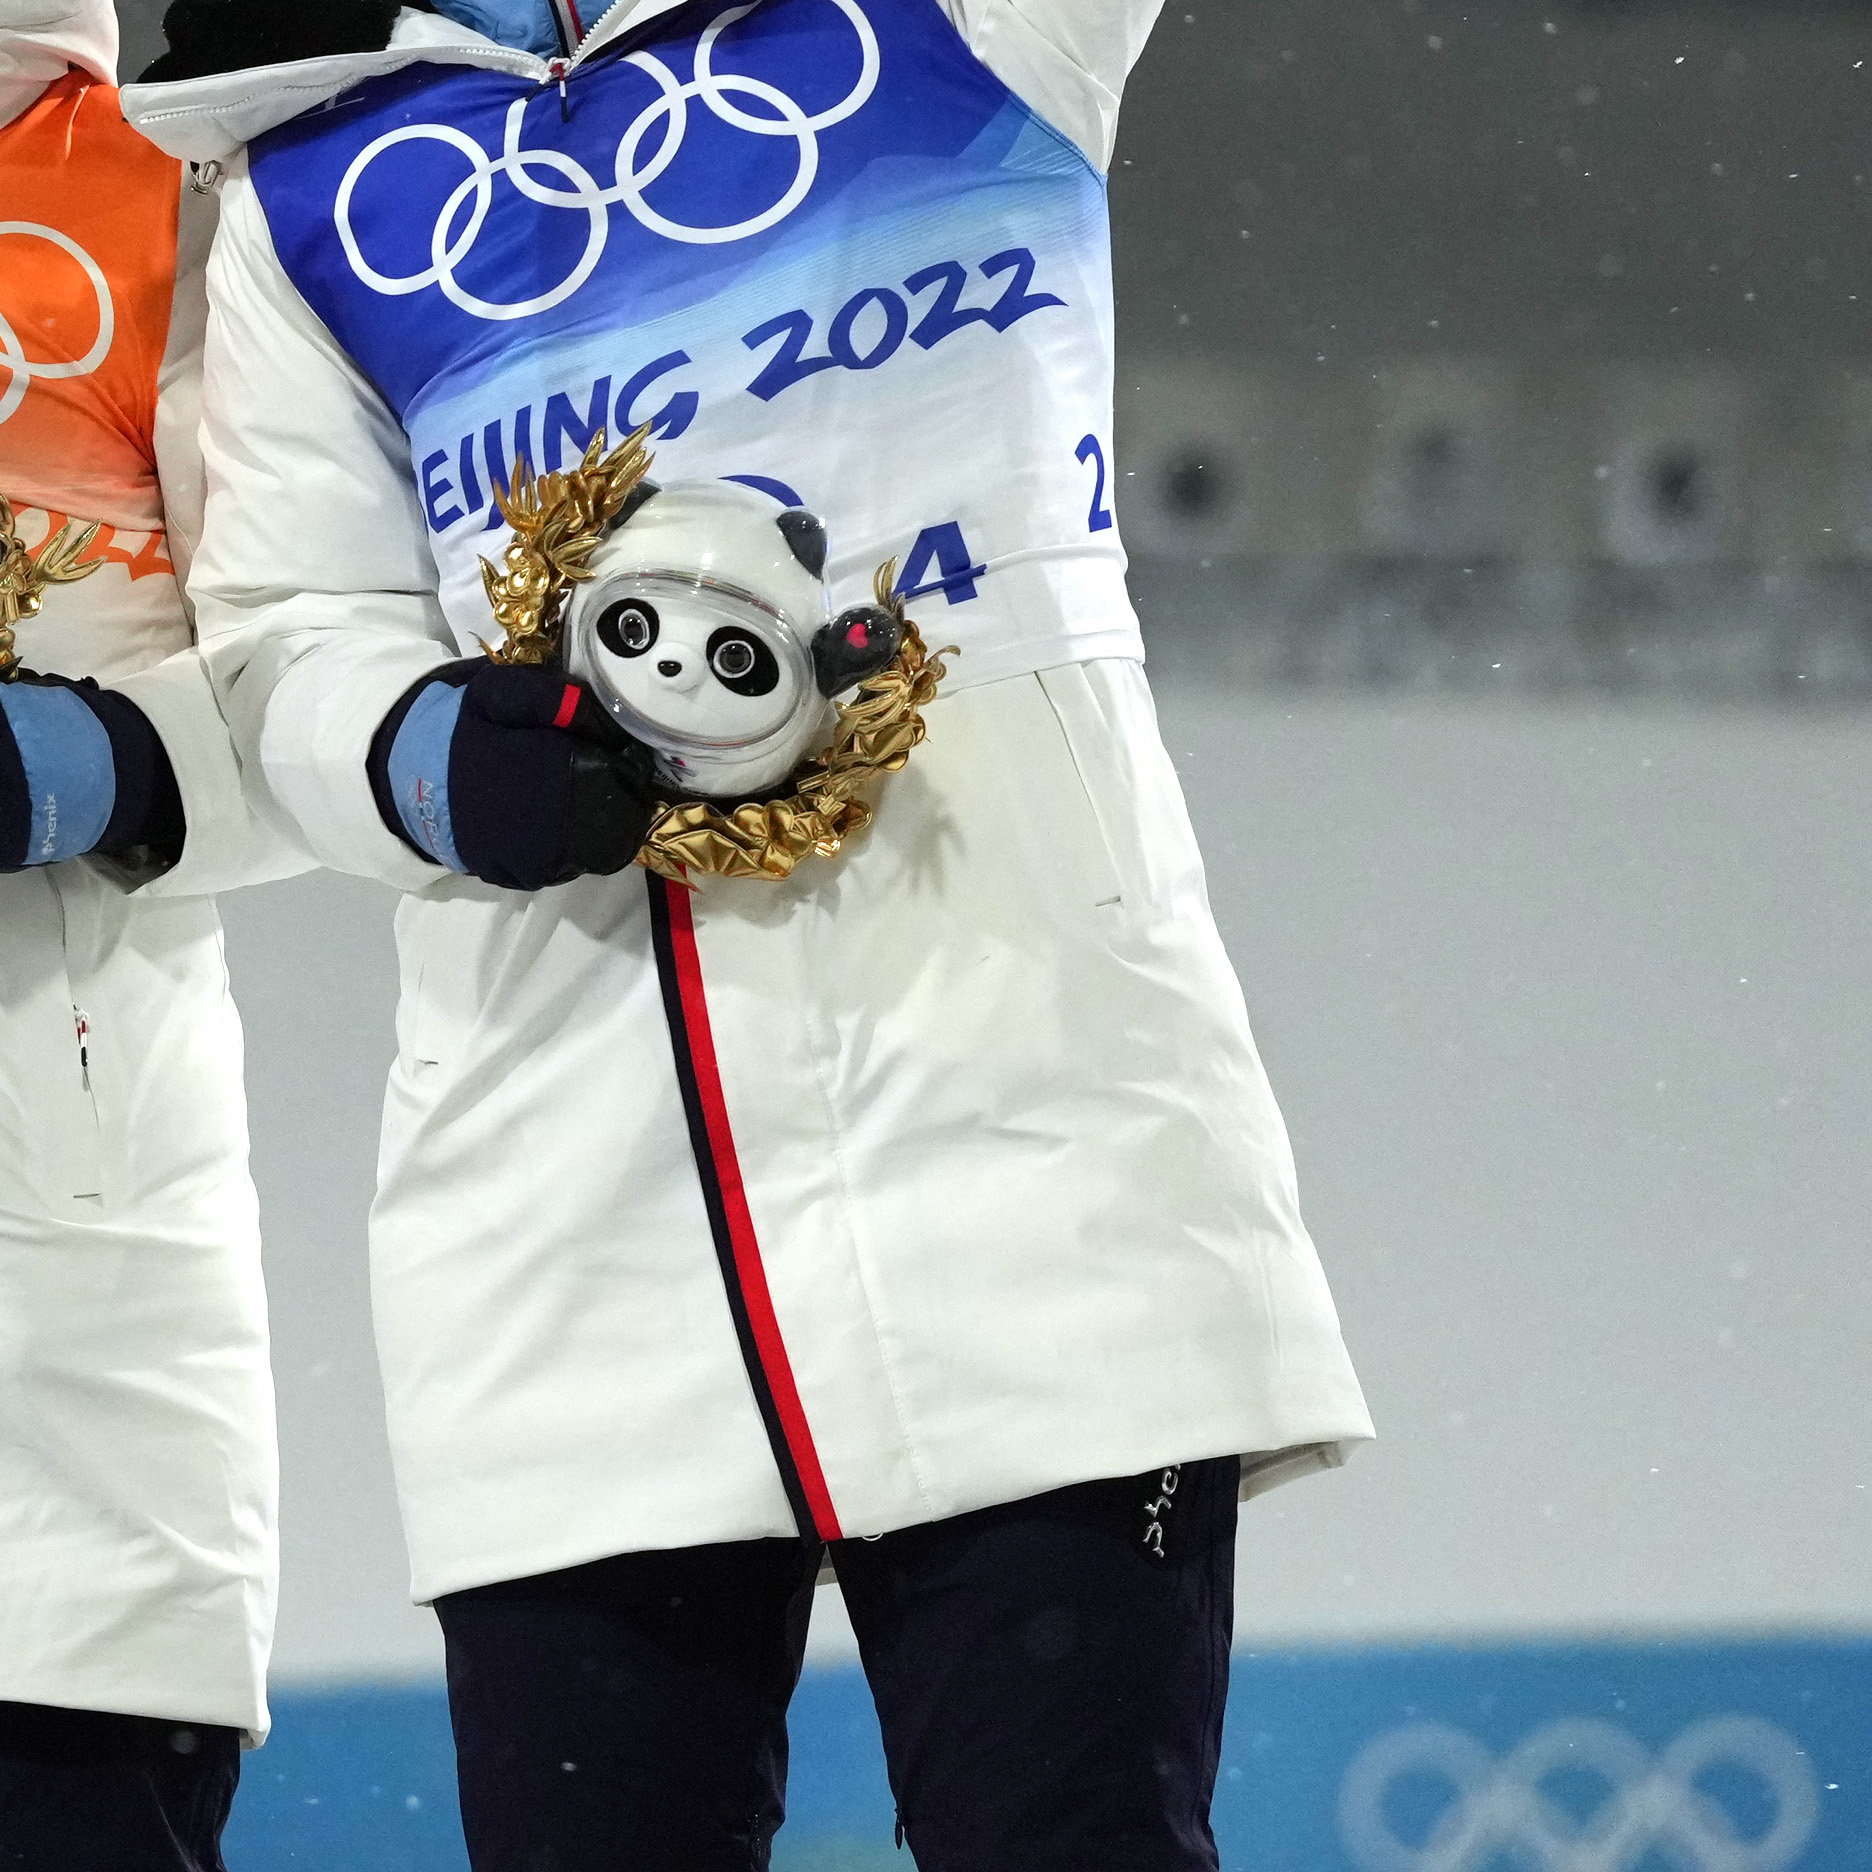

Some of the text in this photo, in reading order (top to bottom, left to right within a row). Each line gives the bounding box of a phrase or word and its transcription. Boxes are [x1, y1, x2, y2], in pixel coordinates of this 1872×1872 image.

[421, 247, 1069, 534] EIJING 2022
[1074, 433, 1113, 533] 2
